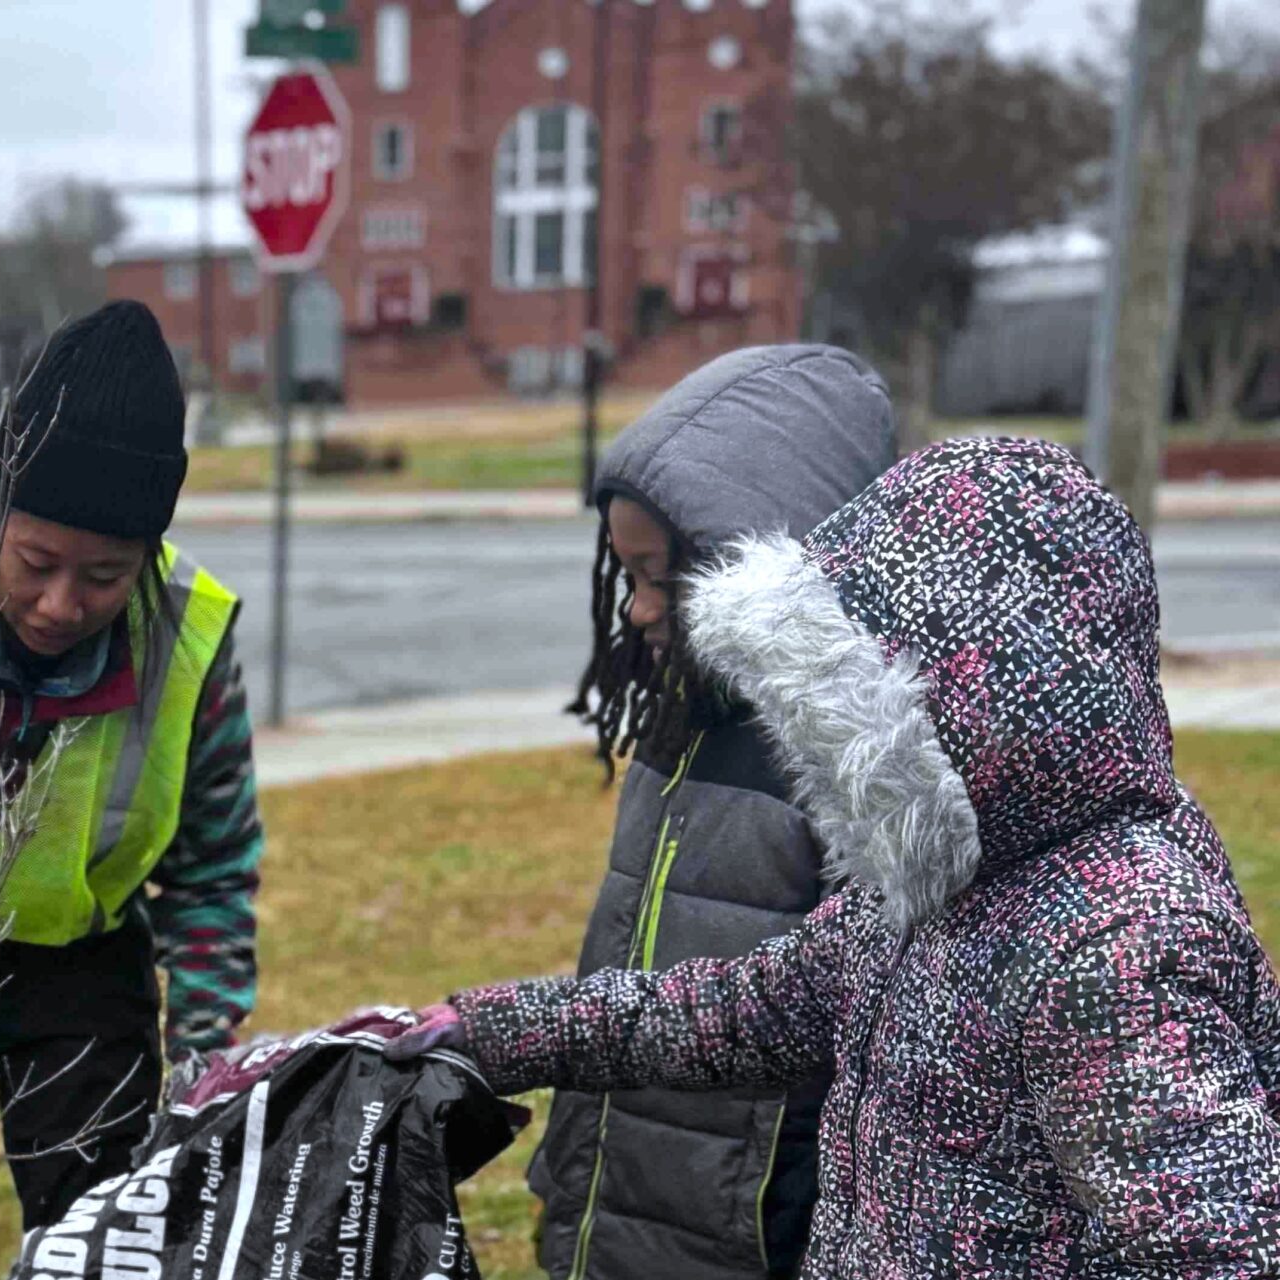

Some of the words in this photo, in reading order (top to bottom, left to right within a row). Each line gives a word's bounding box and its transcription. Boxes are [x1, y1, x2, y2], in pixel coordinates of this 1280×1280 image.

[246, 124, 341, 207] STOP
[348, 1101, 385, 1174] Growth
[200, 1136, 224, 1204] Pajote
[273, 1143, 311, 1236] Watering
[373, 1144, 388, 1187] maleza
[339, 1181, 366, 1240] Weed
[369, 1189, 381, 1205] de
[193, 1209, 217, 1262] Dura
[445, 1213, 462, 1237] FT
[288, 1250, 303, 1280] riego
[439, 1241, 458, 1269] CU
